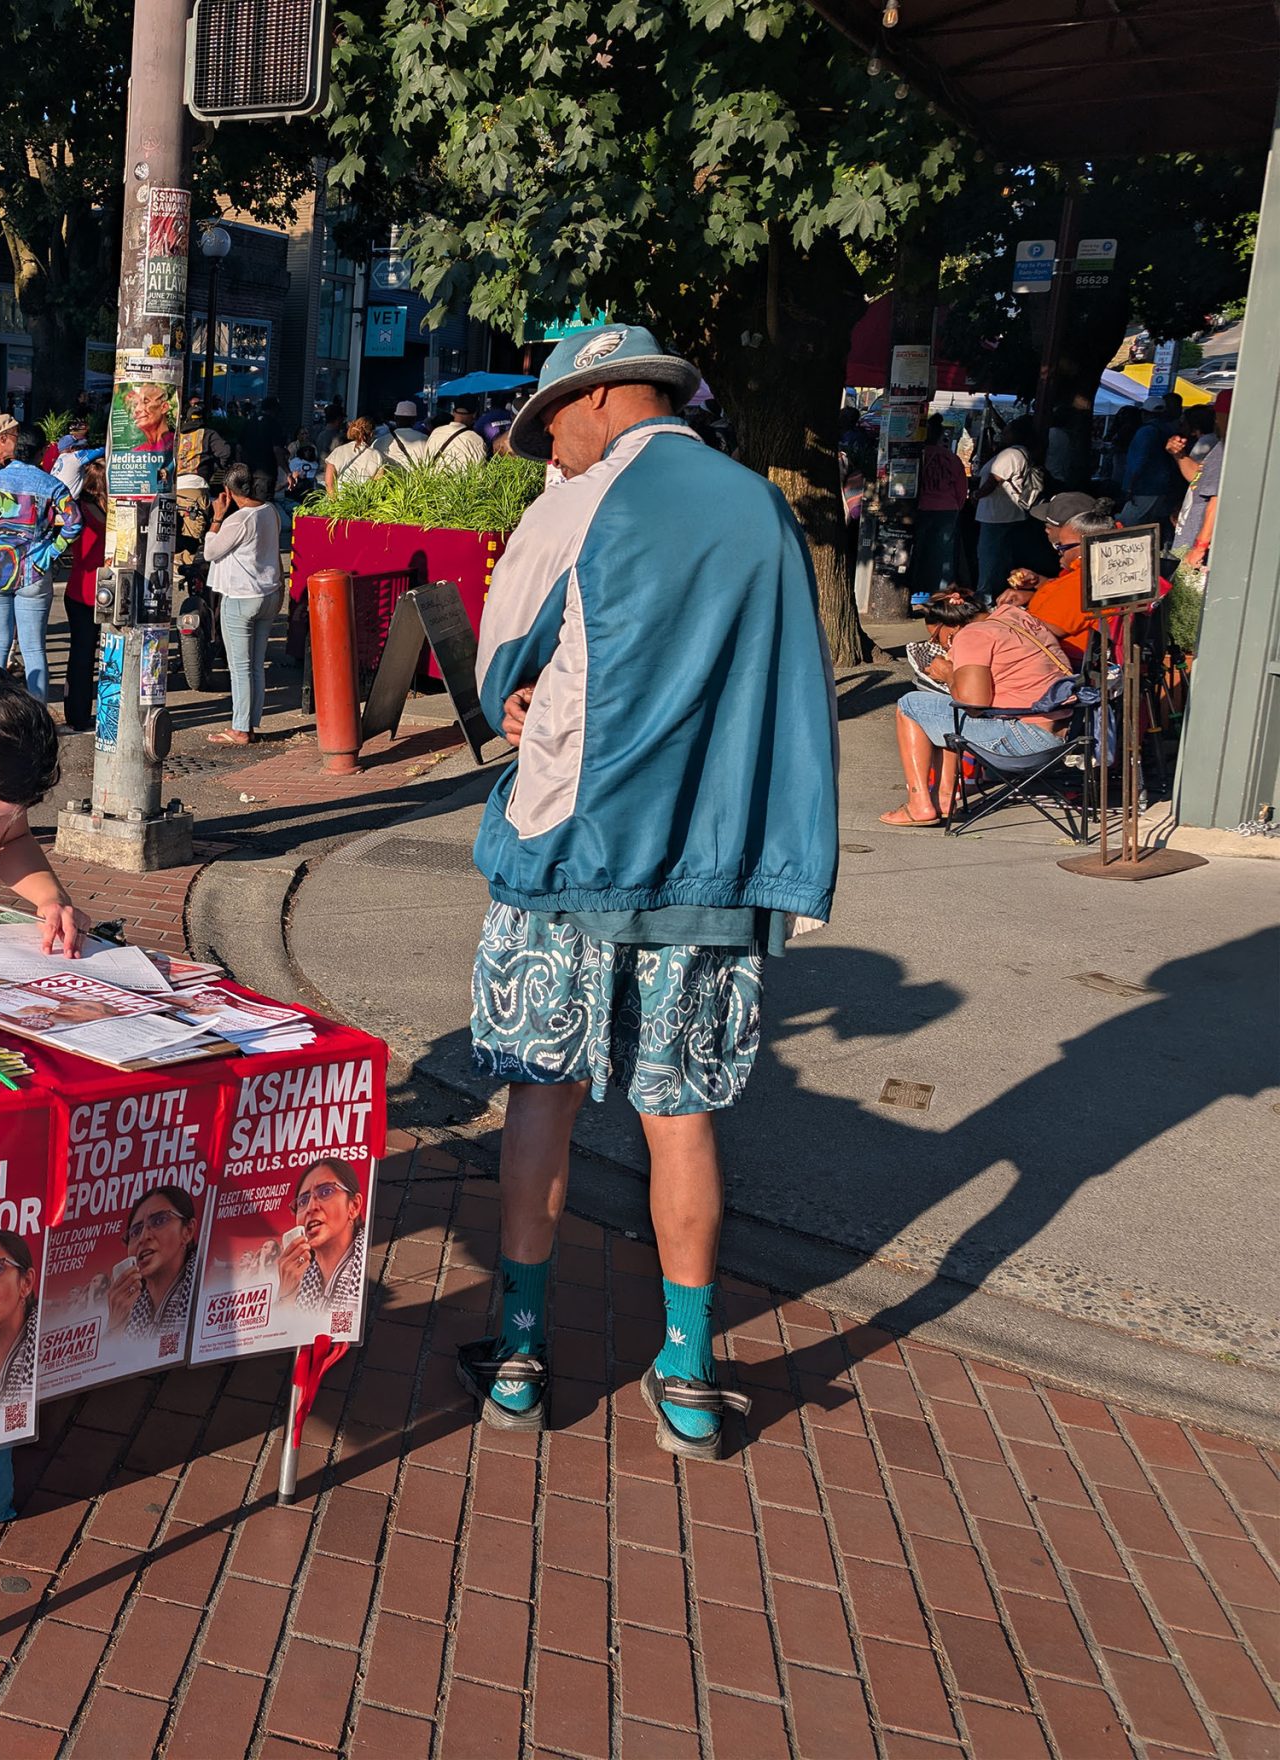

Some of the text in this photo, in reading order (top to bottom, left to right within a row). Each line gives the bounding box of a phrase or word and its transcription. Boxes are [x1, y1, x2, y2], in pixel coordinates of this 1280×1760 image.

[149, 262, 171, 275] DATA
[148, 275, 161, 290] AI
[374, 311, 400, 325] VET
[112, 453, 164, 463] Meditation
[1101, 543, 1144, 558] NO DRINKS
[1108, 558, 1134, 571] BEYOND
[1098, 574, 1114, 586] THIS
[236, 1060, 372, 1118] KSHAMA
[116, 1088, 188, 1134] OUT!
[228, 1102, 372, 1160] SAWANT
[141, 1124, 200, 1168] THE
[224, 1145, 368, 1178] FOR U.S. CONGRESS
[220, 1183, 290, 1205] ELECT THE SOCIALIST
[217, 1198, 282, 1220] MONEY CAN'T BUY!
[71, 1224, 102, 1240] DOWN
[104, 1220, 123, 1234] THE
[48, 1240, 96, 1263] ETENTION
[46, 1256, 86, 1277] ENTERS!
[208, 1288, 267, 1312] KSHAMA
[206, 1302, 267, 1326] SAWANT
[218, 1322, 228, 1332] FOR
[240, 1316, 266, 1328] CONGRESS
[39, 1336, 96, 1364] AWANT
